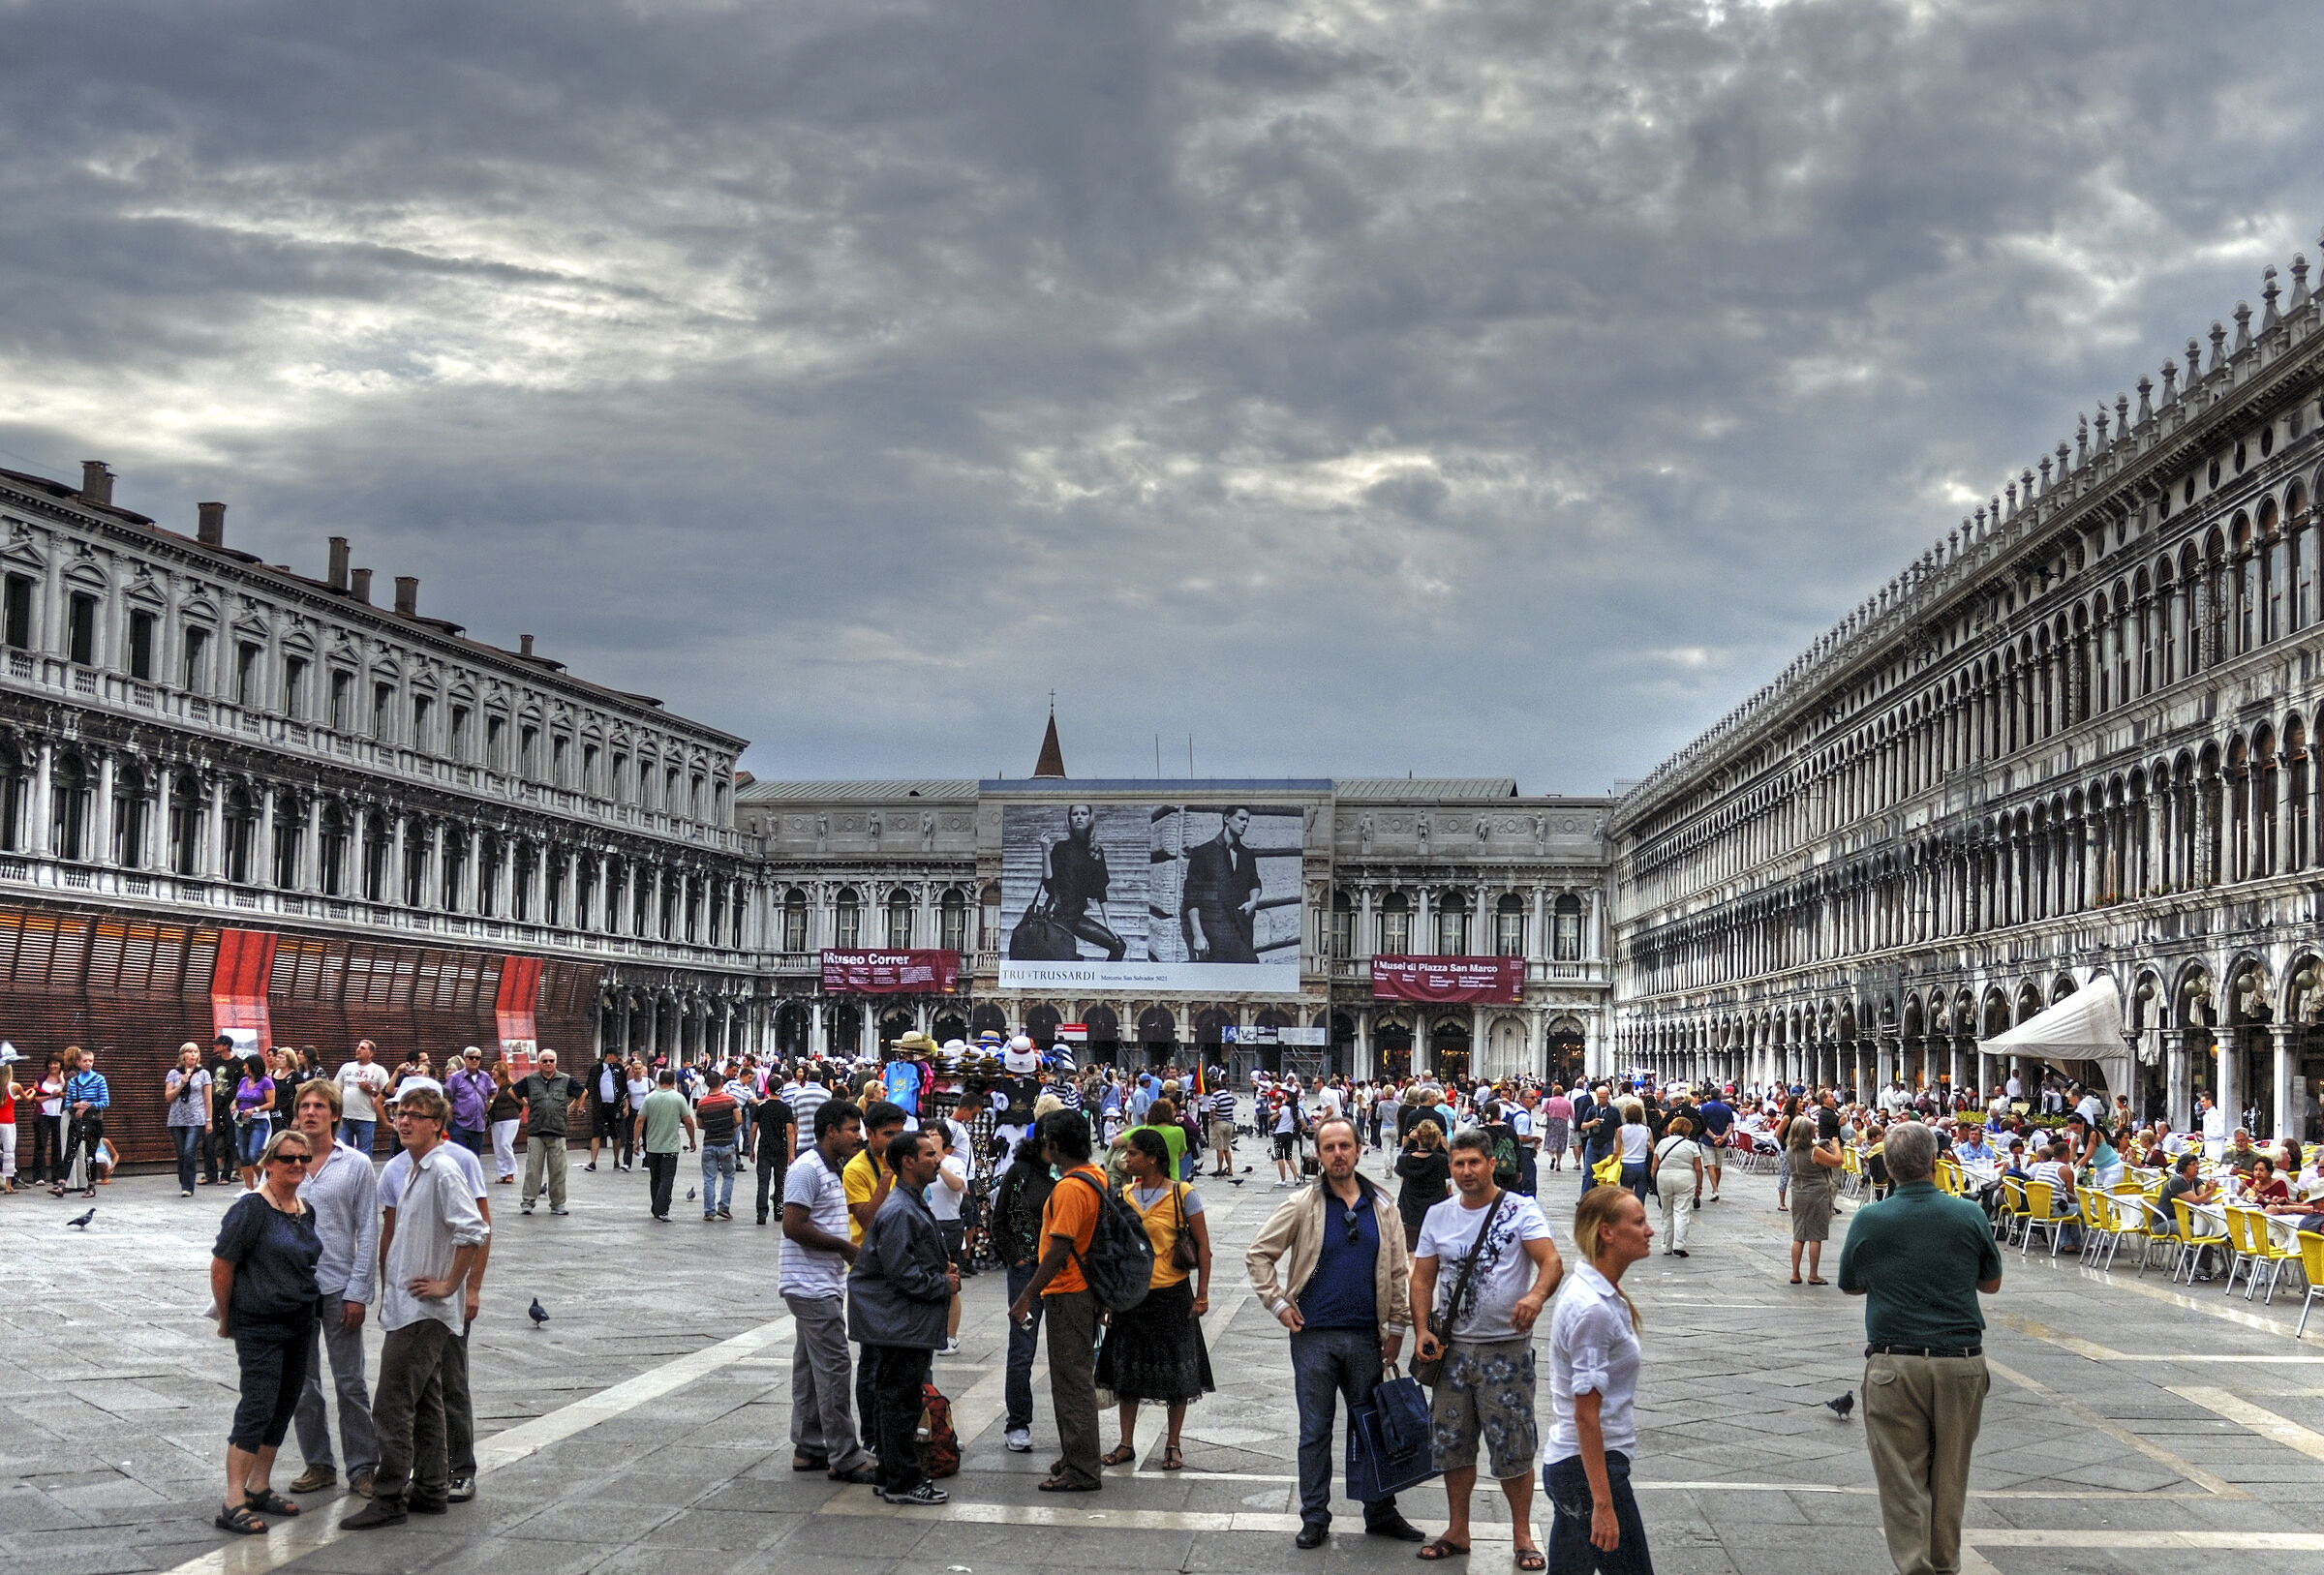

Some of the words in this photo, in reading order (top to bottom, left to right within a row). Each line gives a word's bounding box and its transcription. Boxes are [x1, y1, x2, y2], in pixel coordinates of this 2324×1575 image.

[823, 952, 865, 964] Museo
[868, 953, 909, 965] Correr
[1379, 961, 1406, 971] Musei
[1407, 962, 1417, 971] di
[1419, 963, 1448, 972] Piazza
[1450, 963, 1468, 973] San
[1469, 964, 1498, 973] Marco
[1002, 970, 1024, 980] TRU
[1032, 970, 1096, 981] TRUSSARDI
